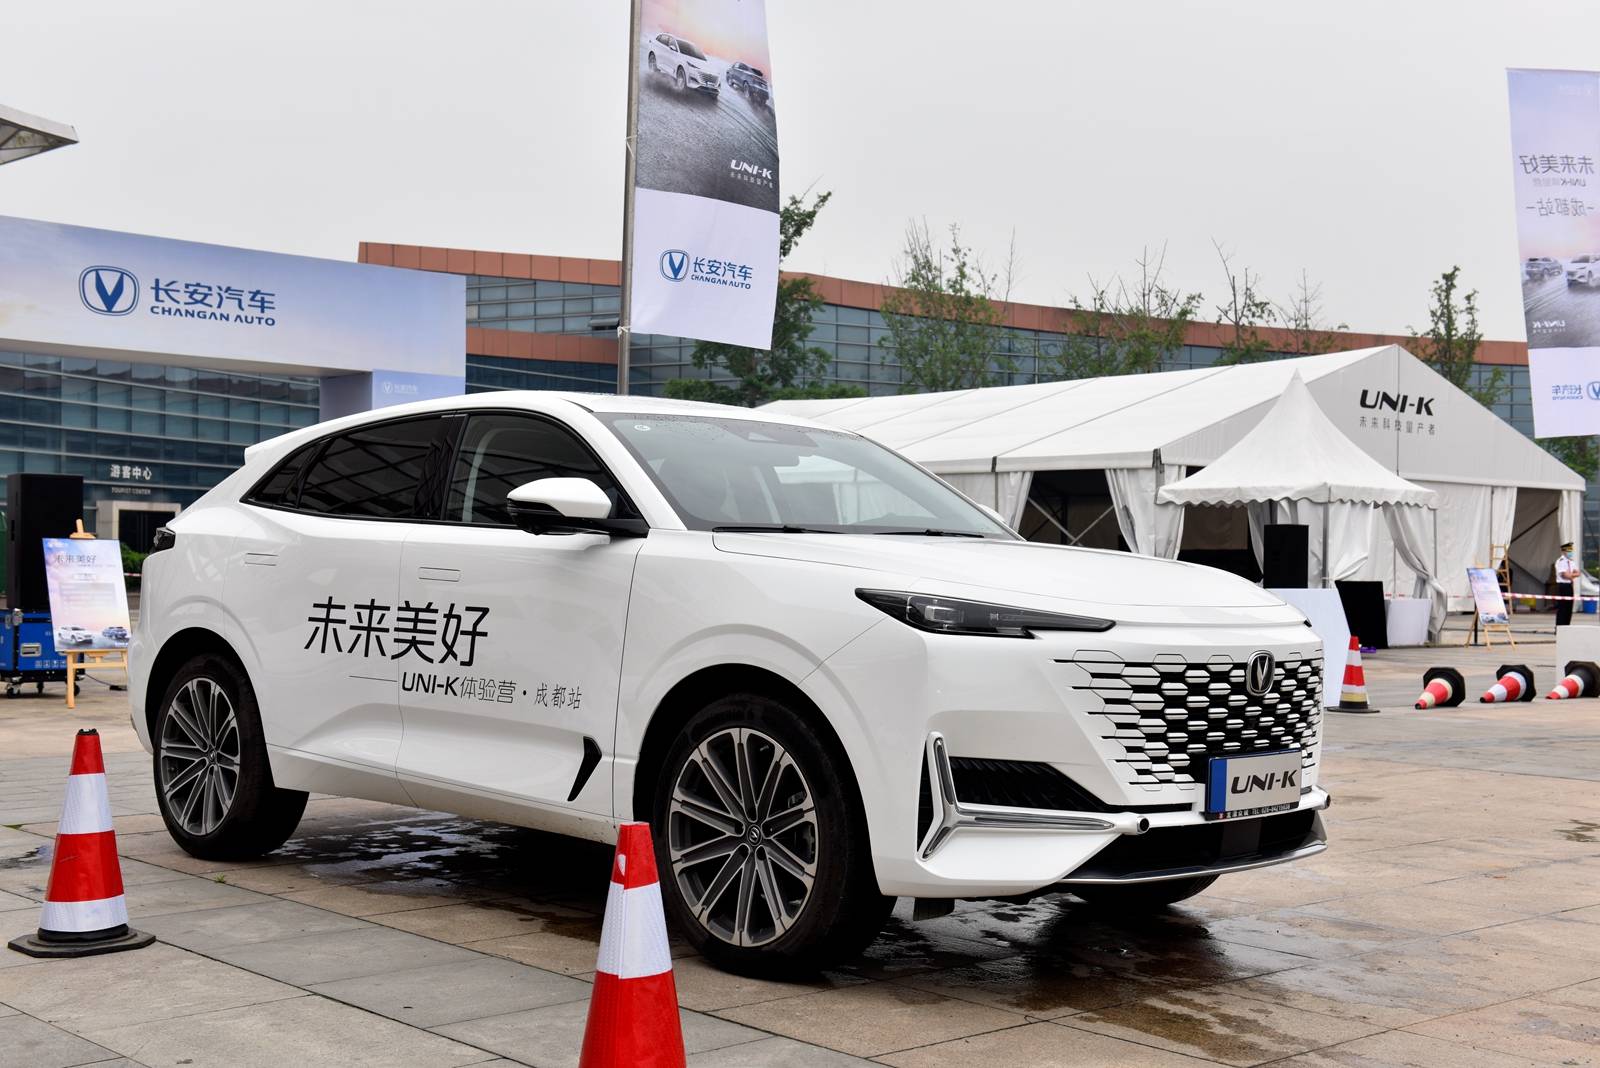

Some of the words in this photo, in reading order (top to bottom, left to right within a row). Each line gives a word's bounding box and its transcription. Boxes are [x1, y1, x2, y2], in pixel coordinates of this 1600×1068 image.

[731, 160, 772, 179] UNI-K
[693, 256, 753, 281] 长安汽车
[691, 274, 728, 286] CHANGAN
[728, 280, 751, 290] AUTO
[150, 278, 276, 314] 长安汽车
[150, 305, 230, 322] CHANGAN
[234, 314, 276, 327] AUTO
[1360, 389, 1435, 416] UNI-K
[1360, 416, 1435, 436] 未来科技量产者
[110, 464, 152, 480] 游客中心
[304, 596, 490, 667] 未来美好
[1231, 769, 1298, 794] UNI-K
